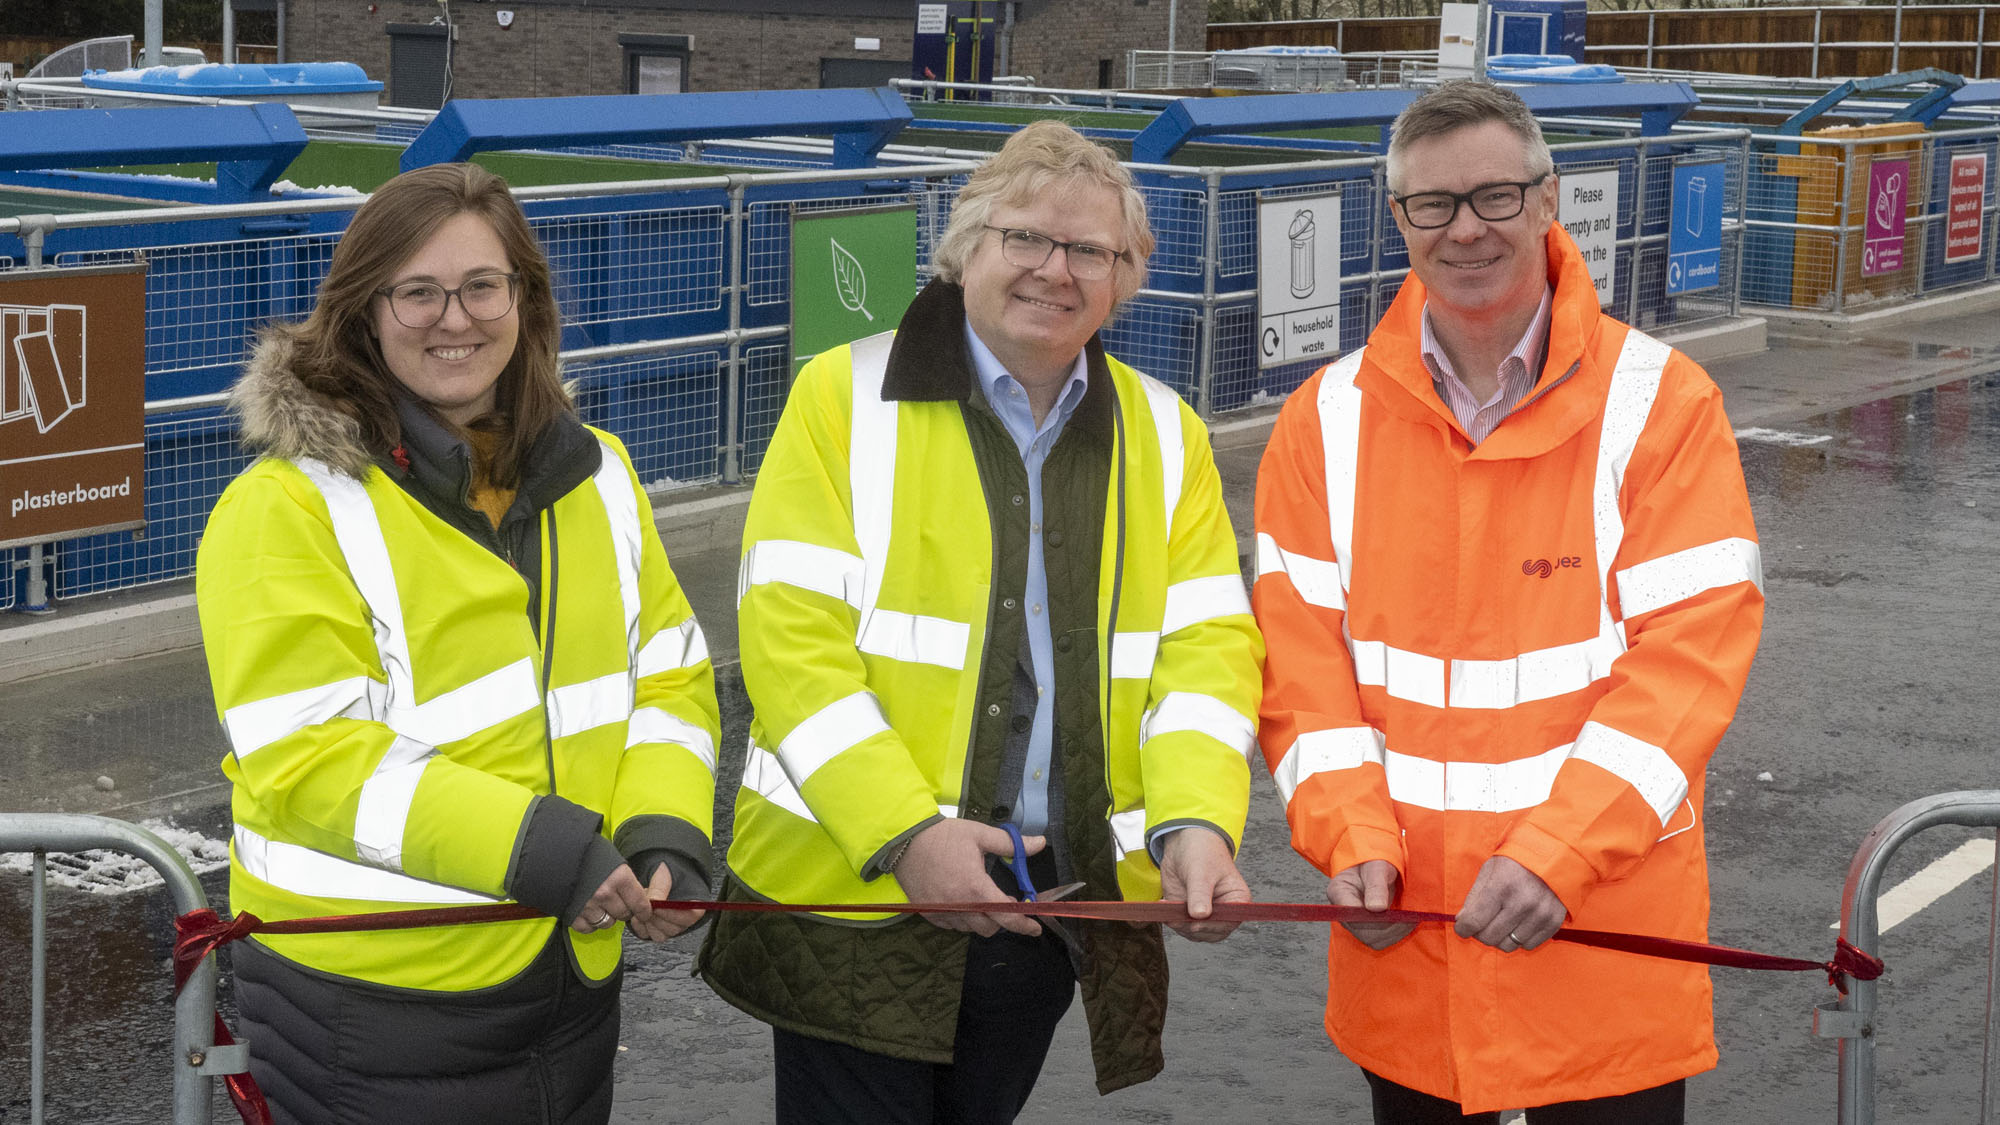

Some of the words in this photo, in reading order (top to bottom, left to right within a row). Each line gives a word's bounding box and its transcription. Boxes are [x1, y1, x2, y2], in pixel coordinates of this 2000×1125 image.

[1965, 167, 1978, 175] mobile
[1573, 187, 1603, 204] Please
[1952, 185, 1968, 195] devices
[1968, 184, 1977, 194] must
[1955, 202, 1967, 213] wiped
[1564, 218, 1592, 237] empty
[1593, 215, 1610, 232] and
[1952, 220, 1969, 231] personal
[1969, 218, 1978, 228] data
[1949, 238, 1962, 247] before
[1962, 235, 1979, 246] disposal
[1593, 244, 1607, 262] the
[1688, 262, 1716, 276] cardboard
[1293, 314, 1333, 335] household
[1301, 340, 1325, 353] waste
[11, 476, 130, 518] plasterboard
